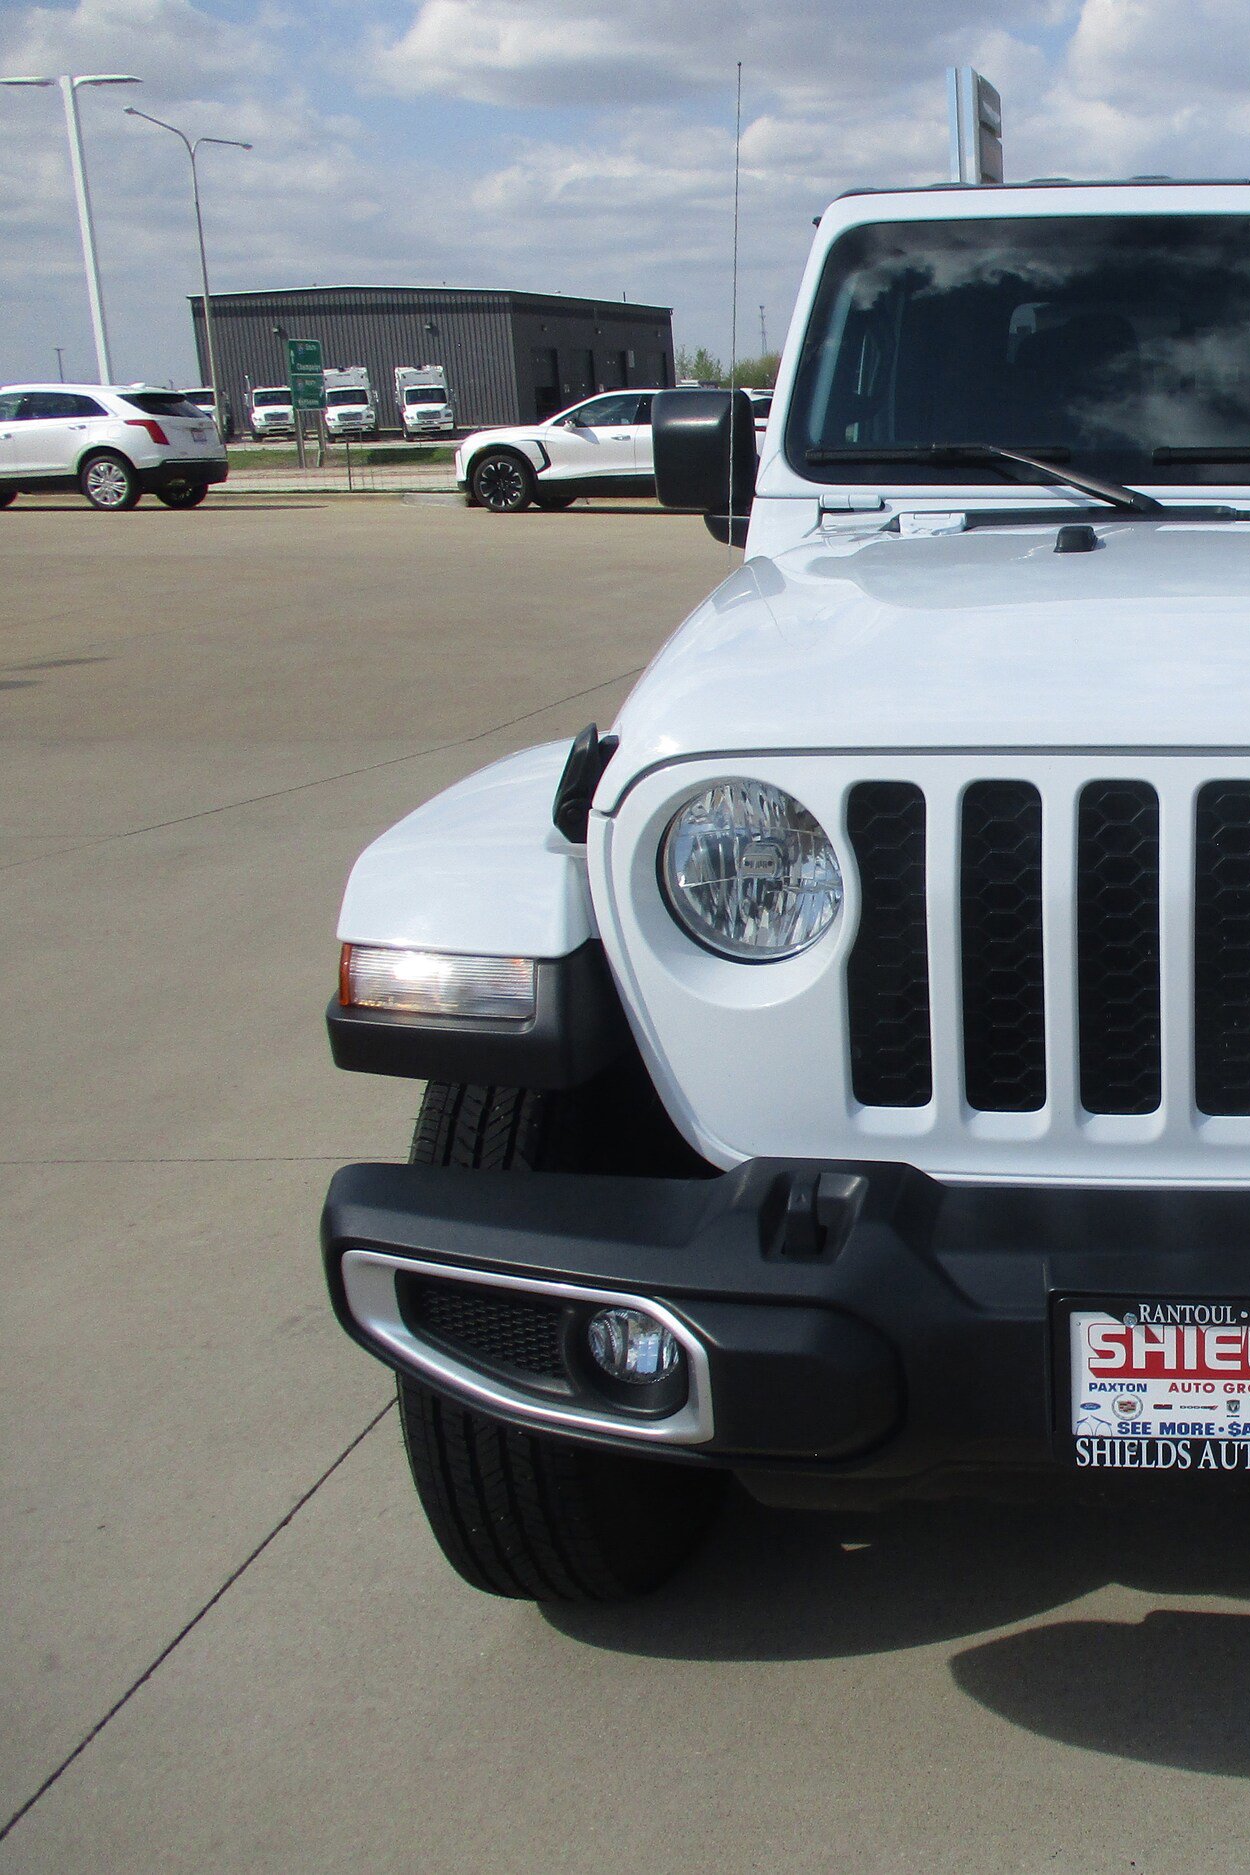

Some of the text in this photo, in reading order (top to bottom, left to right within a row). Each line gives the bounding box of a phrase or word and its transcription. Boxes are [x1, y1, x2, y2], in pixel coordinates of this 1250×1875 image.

[1138, 1304, 1237, 1325] RANTOUL
[1088, 1382, 1148, 1393] PAXTON
[1168, 1382, 1216, 1394] AUTO
[1117, 1421, 1152, 1436] SEE
[1159, 1422, 1216, 1436] MORE
[1075, 1438, 1192, 1470] SHIELDS
